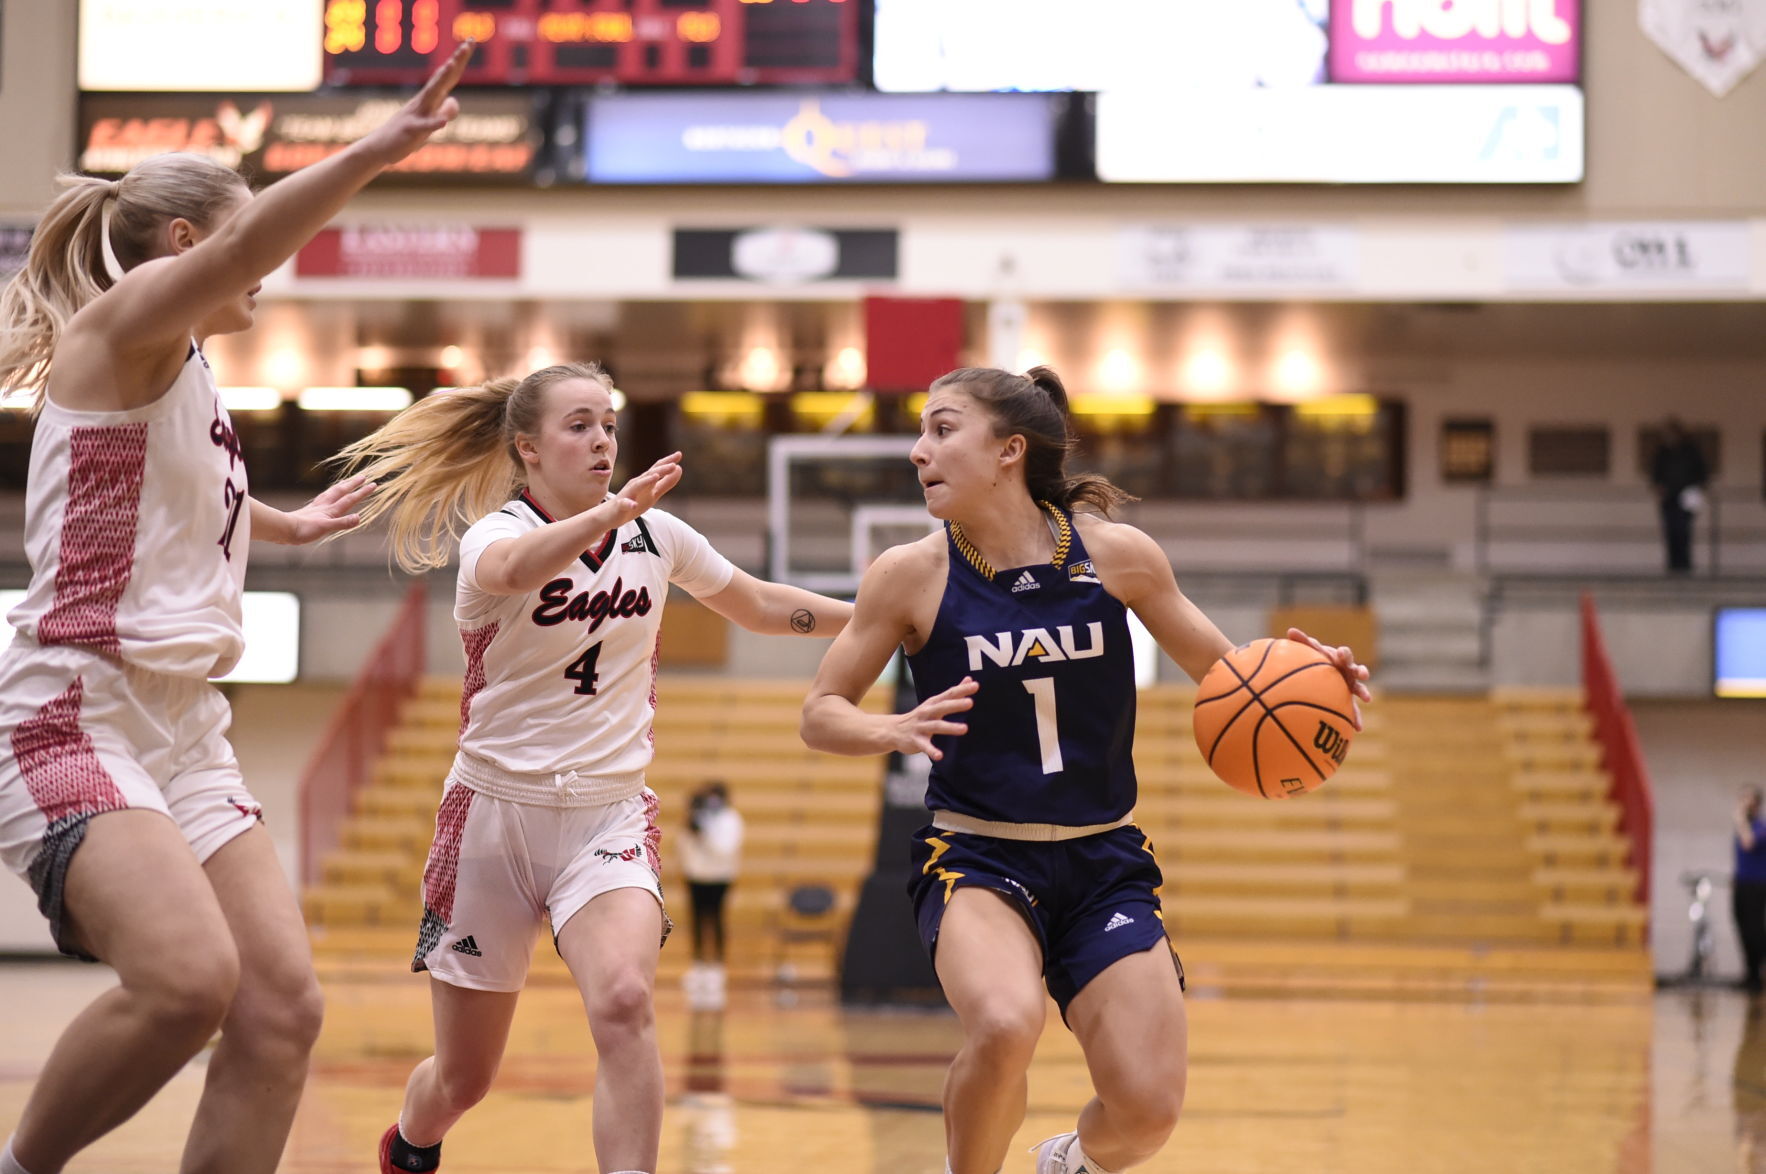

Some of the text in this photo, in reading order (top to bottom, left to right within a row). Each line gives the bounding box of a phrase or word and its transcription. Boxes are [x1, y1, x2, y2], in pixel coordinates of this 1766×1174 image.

[1011, 582, 1041, 593] adidas
[1070, 562, 1097, 575] BIGSK
[532, 576, 652, 634] Eagles
[564, 640, 603, 695] 4
[963, 621, 1104, 671] NAU
[1022, 677, 1064, 775] 1
[1313, 720, 1349, 766] Wil
[1104, 918, 1135, 932] adidas
[451, 944, 482, 957] adidas
